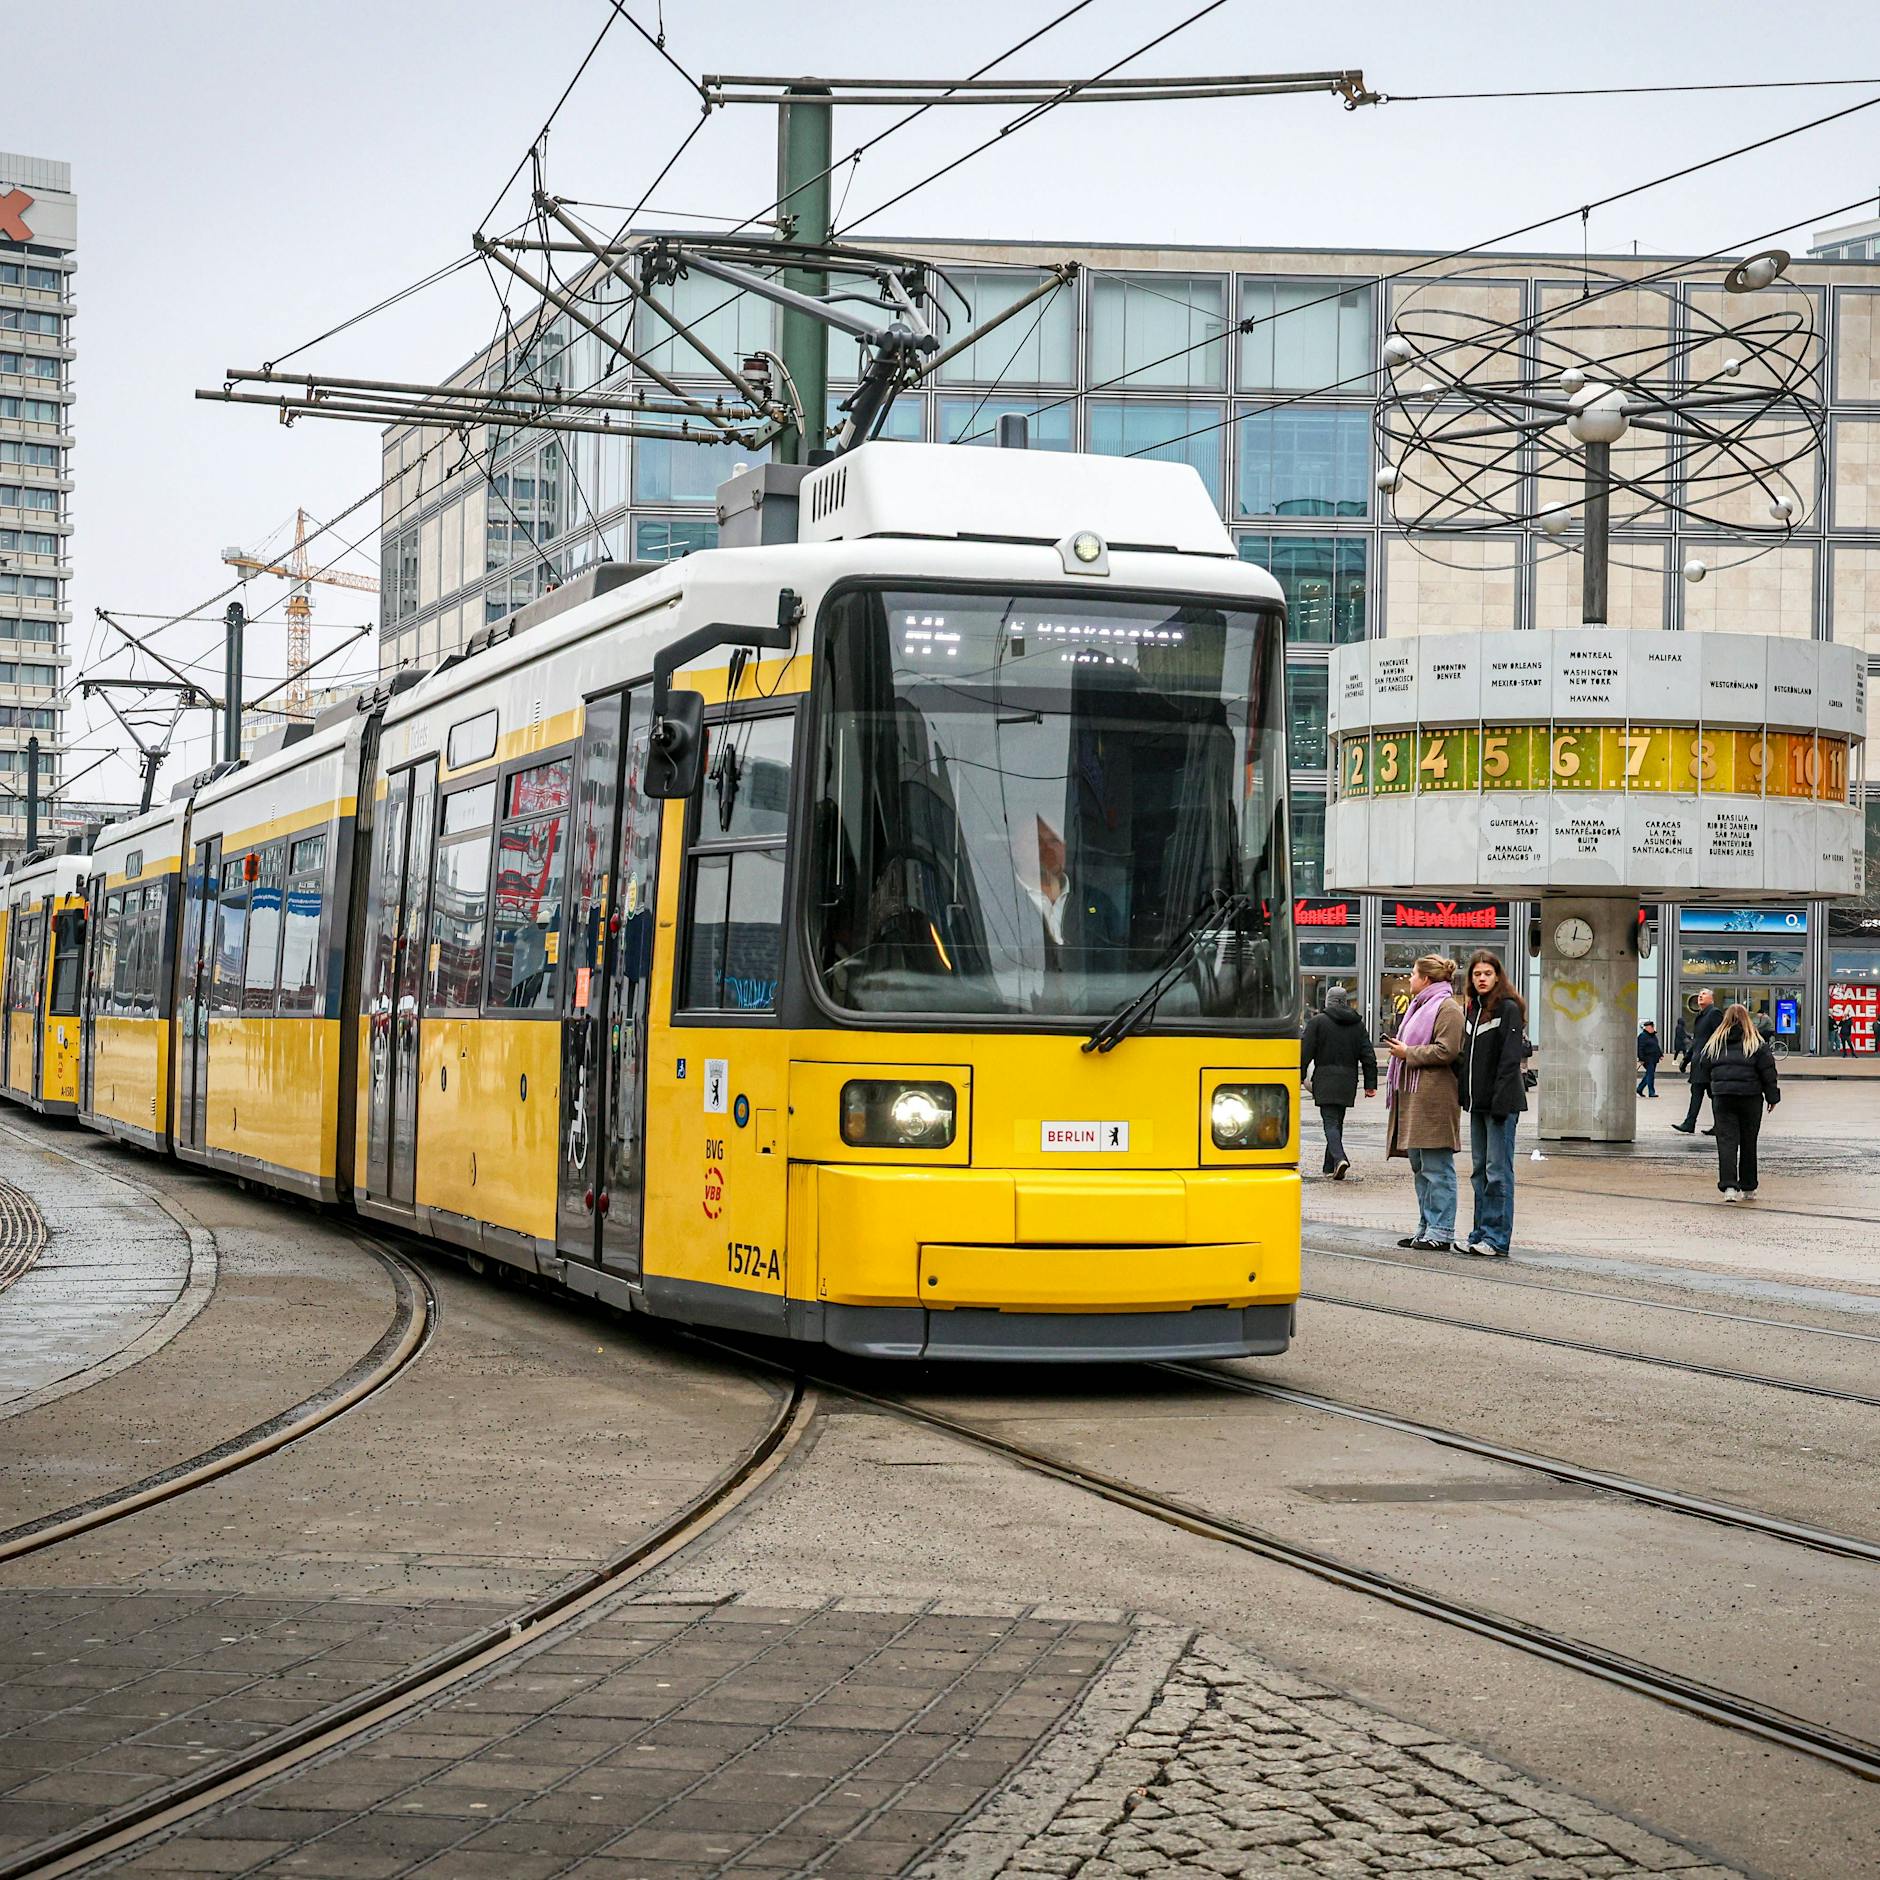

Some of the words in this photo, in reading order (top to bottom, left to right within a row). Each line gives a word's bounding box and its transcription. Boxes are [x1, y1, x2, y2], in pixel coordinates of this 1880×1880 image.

[1570, 651, 1613, 659] MONTREAL
[1648, 654, 1682, 662] HALIFAX
[1379, 658, 1409, 667] VANCOUVER
[1433, 663, 1466, 671] EDMONTON
[1492, 662, 1508, 670] NEW
[1510, 661, 1542, 669] ORLEANS
[1383, 667, 1405, 675] DAWSON
[1375, 677, 1384, 685] SAN
[1386, 675, 1414, 684] FRANCISCO
[1436, 672, 1461, 680] DENVER
[1491, 679, 1542, 687] MEXIKO-STADT
[1710, 680, 1758, 690] WESTGRÖNLAND
[1378, 685, 1387, 693] LOS
[1388, 684, 1409, 692] ANGELES
[1421, 739, 1448, 779] 4
[1484, 737, 1510, 777] 5
[1553, 736, 1580, 777] 6
[1618, 736, 1651, 776] 7
[1688, 739, 1717, 780] 8
[1352, 746, 1364, 785] 2
[1381, 743, 1398, 782] 3
[1749, 742, 1774, 782] 9
[1792, 745, 1823, 786] 10
[1830, 750, 1843, 789] 11
[1717, 814, 1749, 822] BRASILIA
[1490, 819, 1538, 827] GUATEMALA-
[1571, 819, 1605, 827] PANAMA
[1645, 821, 1681, 829] CARACAS
[1720, 822, 1727, 830] DE
[1729, 822, 1758, 831] JANEIRO
[1730, 831, 1750, 839] PAULO
[1644, 838, 1682, 846] ASUNCIÓN
[1487, 852, 1529, 861] GALÁPAGOS
[1709, 848, 1734, 856] BUENOS
[1832, 988, 1877, 1001] SALE
[1832, 1004, 1877, 1018] SALE
[1048, 1130, 1095, 1142] BERLIN
[706, 1139, 724, 1160] BVG
[705, 1185, 721, 1201] VBB
[727, 1241, 780, 1281] 1572-A
